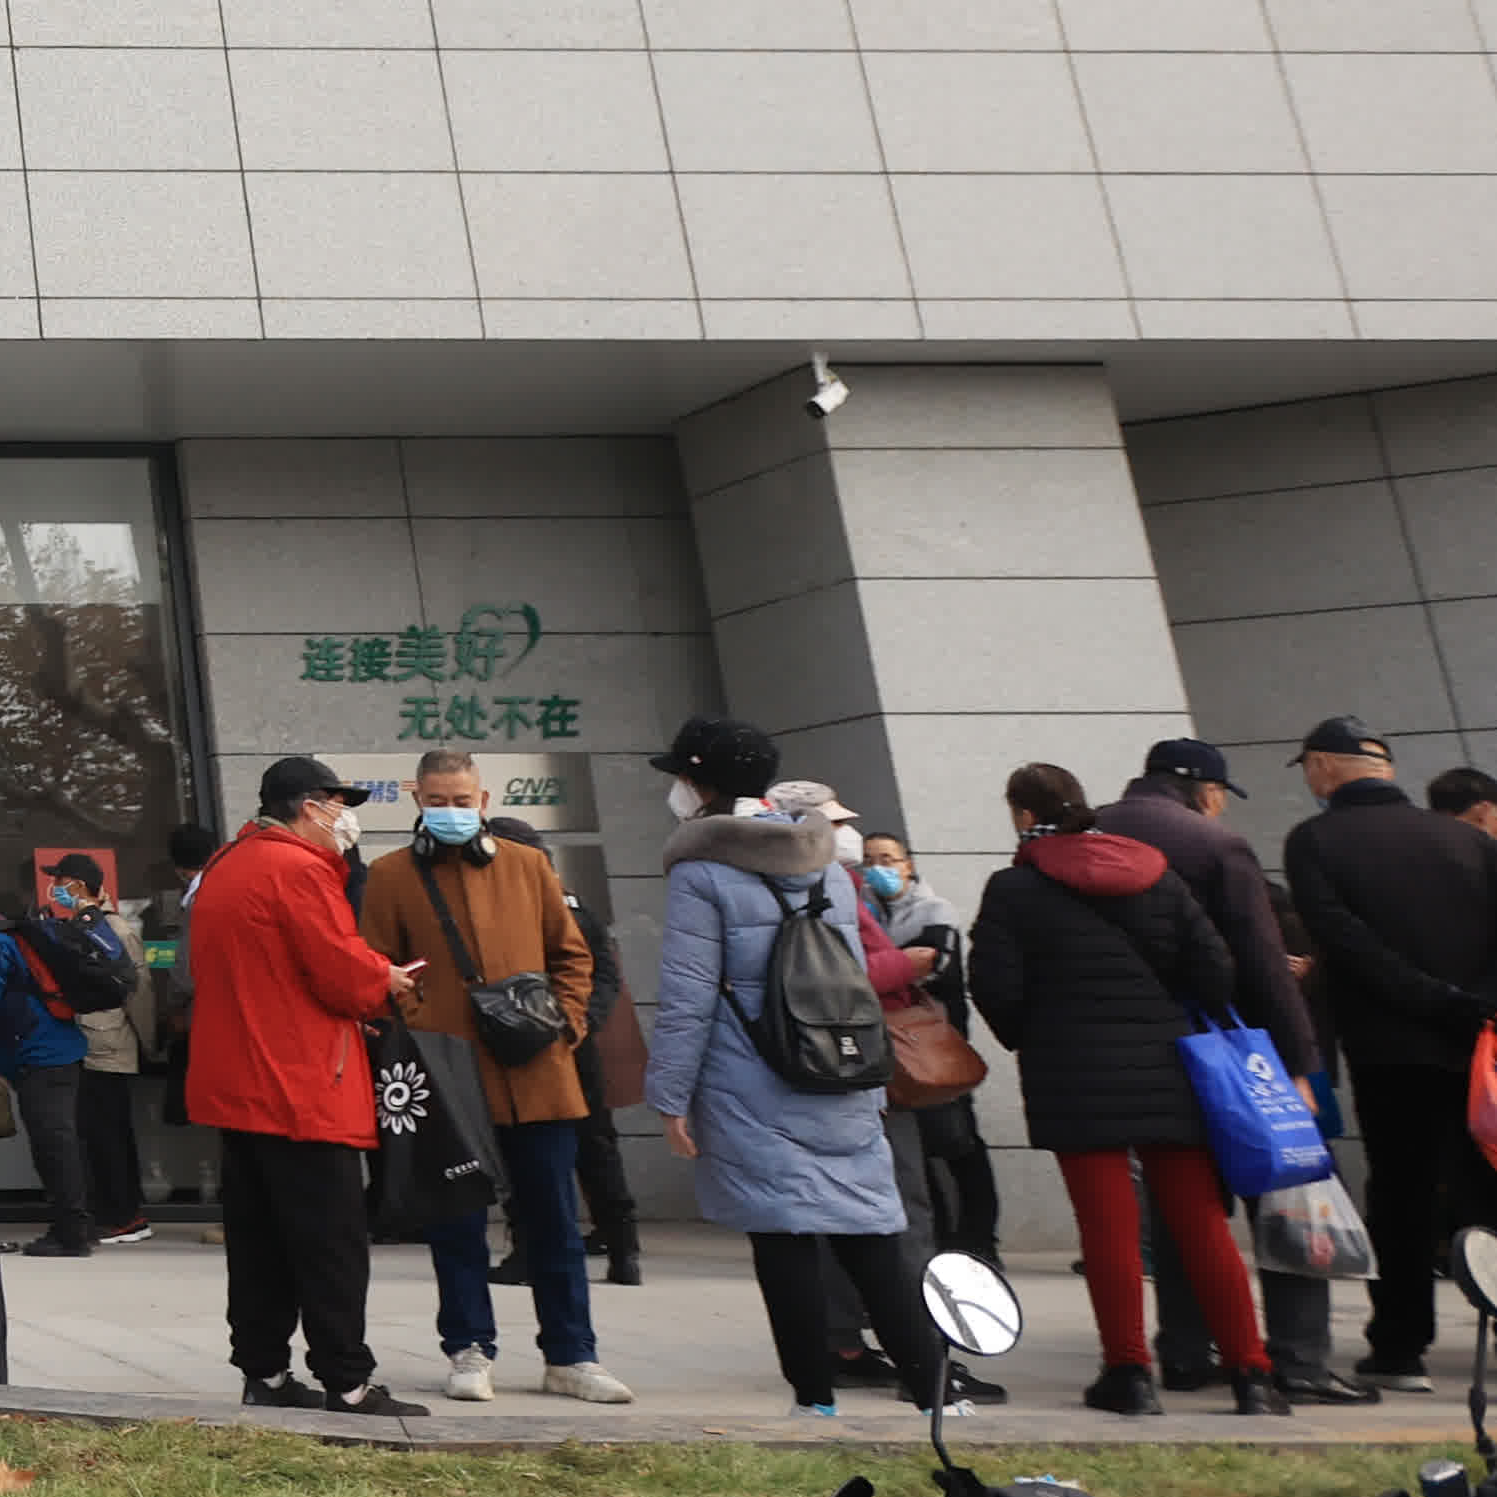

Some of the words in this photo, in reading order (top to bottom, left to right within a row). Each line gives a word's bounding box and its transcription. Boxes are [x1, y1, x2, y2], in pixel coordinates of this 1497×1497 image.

[300, 610, 519, 683] 连接美好
[397, 694, 582, 741] 无处不在
